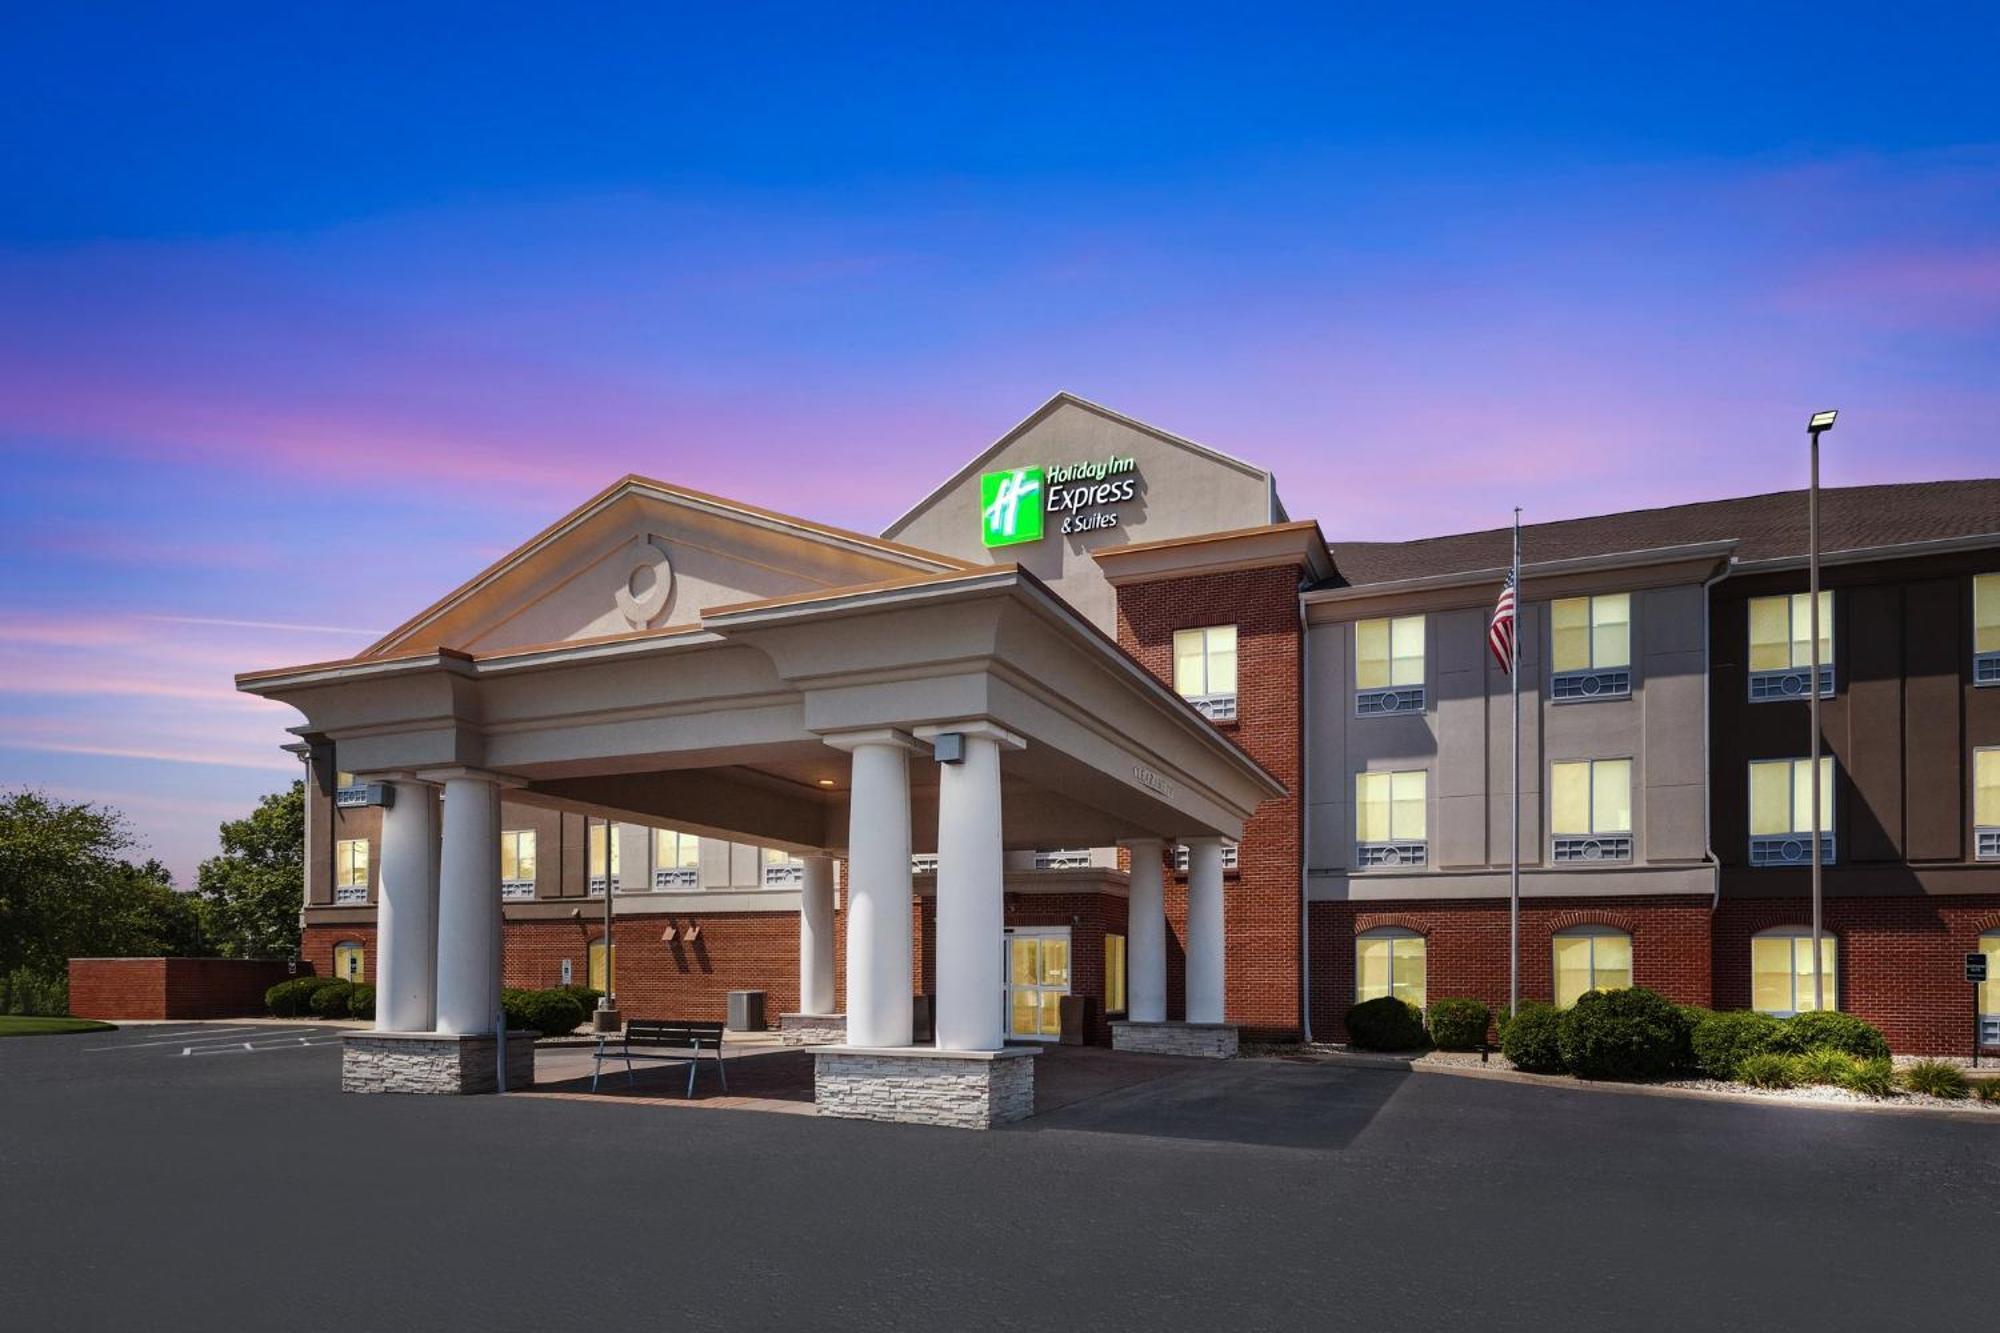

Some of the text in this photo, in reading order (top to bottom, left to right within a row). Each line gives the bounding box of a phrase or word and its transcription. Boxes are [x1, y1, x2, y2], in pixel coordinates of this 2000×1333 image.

[1046, 455, 1135, 485] Holiday Inn
[1046, 479, 1135, 514] Express
[1060, 512, 1117, 534] & Suites
